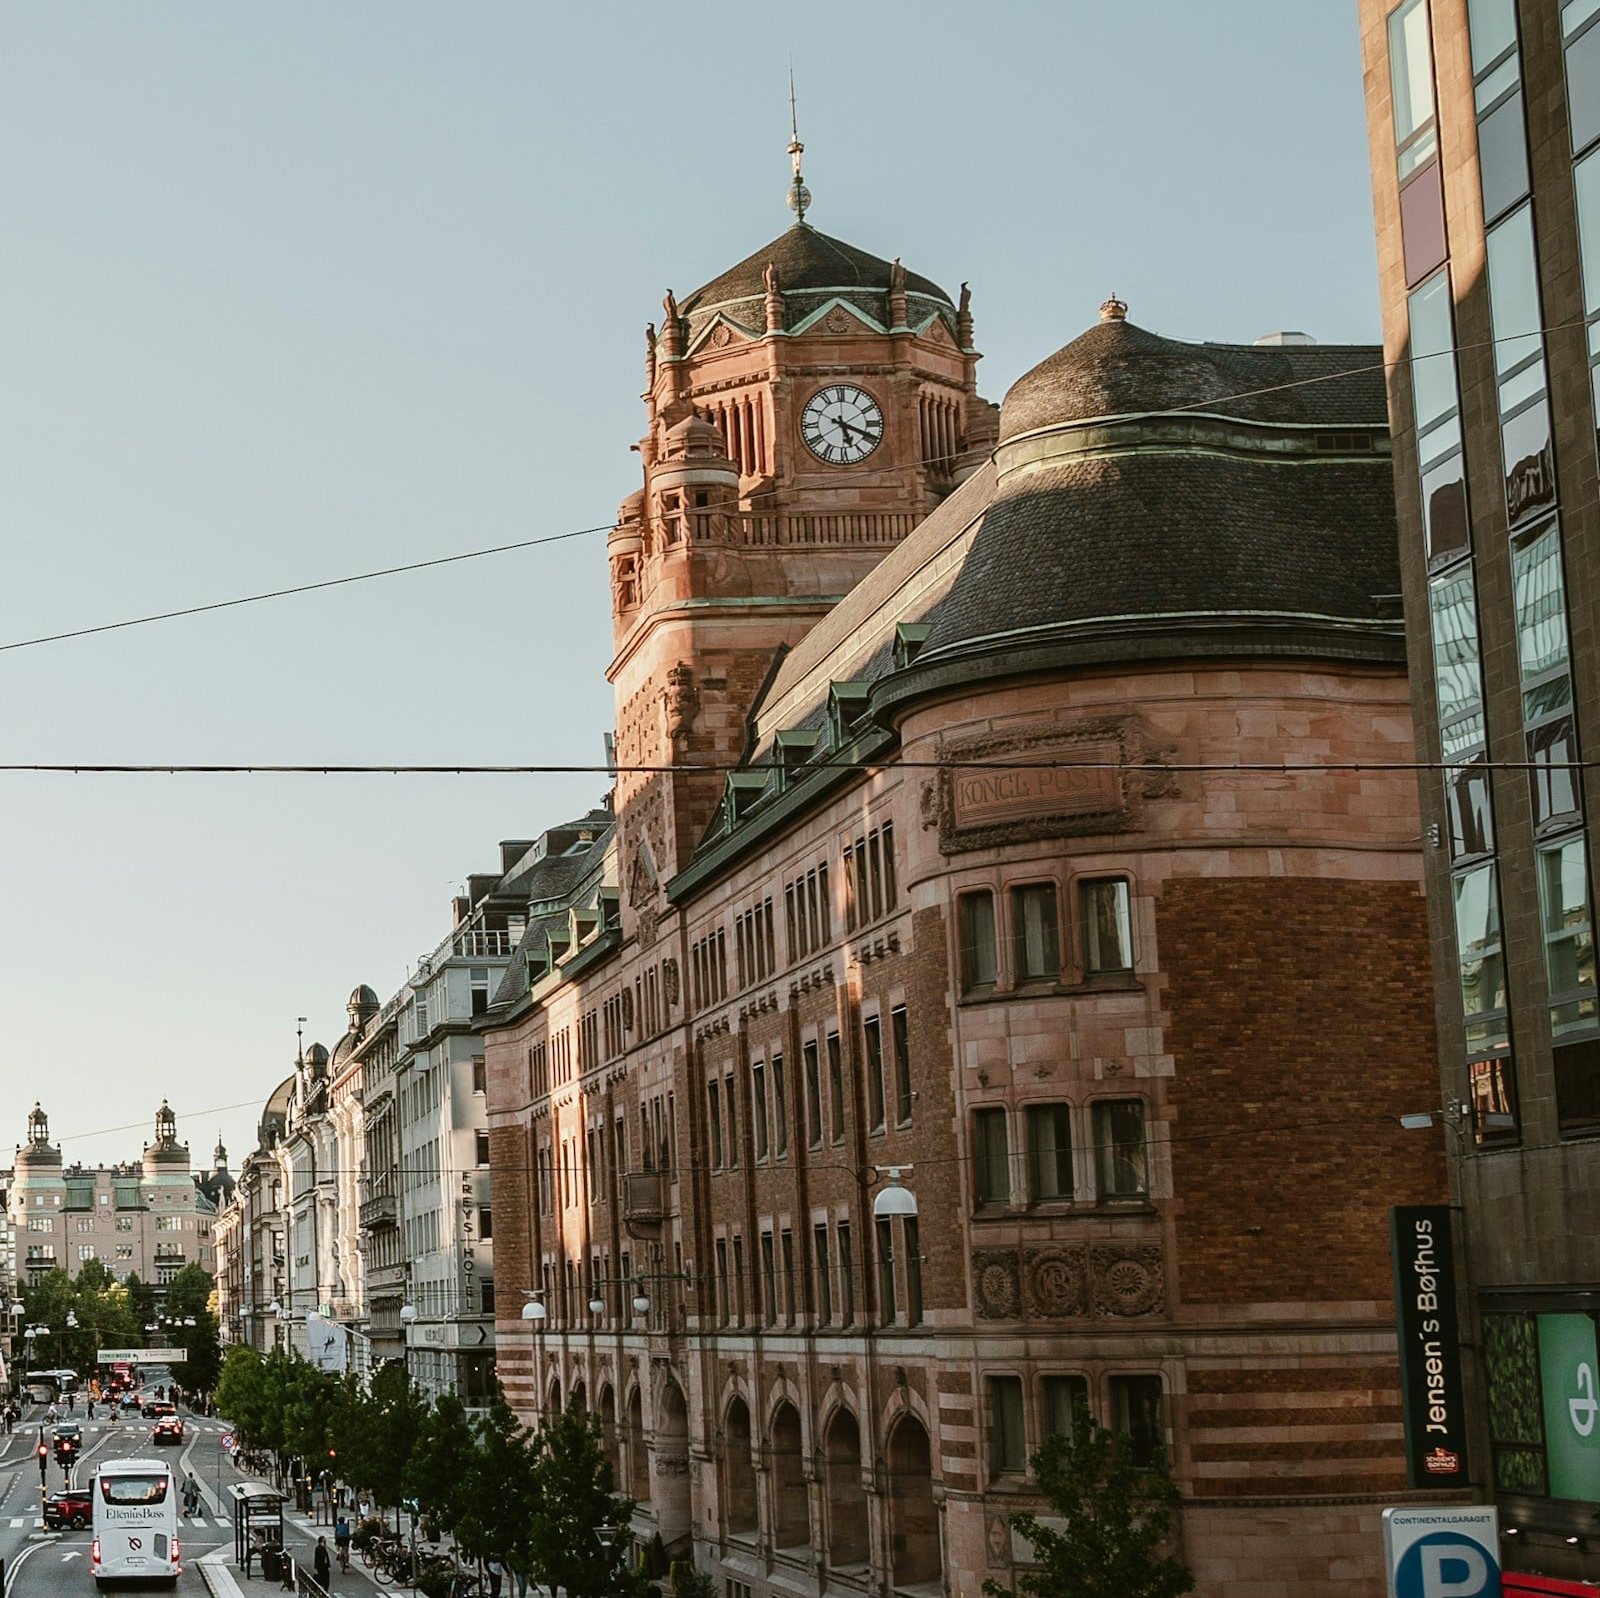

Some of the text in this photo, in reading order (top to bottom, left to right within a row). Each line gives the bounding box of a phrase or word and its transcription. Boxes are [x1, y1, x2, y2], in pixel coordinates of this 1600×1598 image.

[462, 1171, 475, 1310] FREYS HOTEL
[1393, 1515, 1491, 1525] CONTINENTALGARAGET
